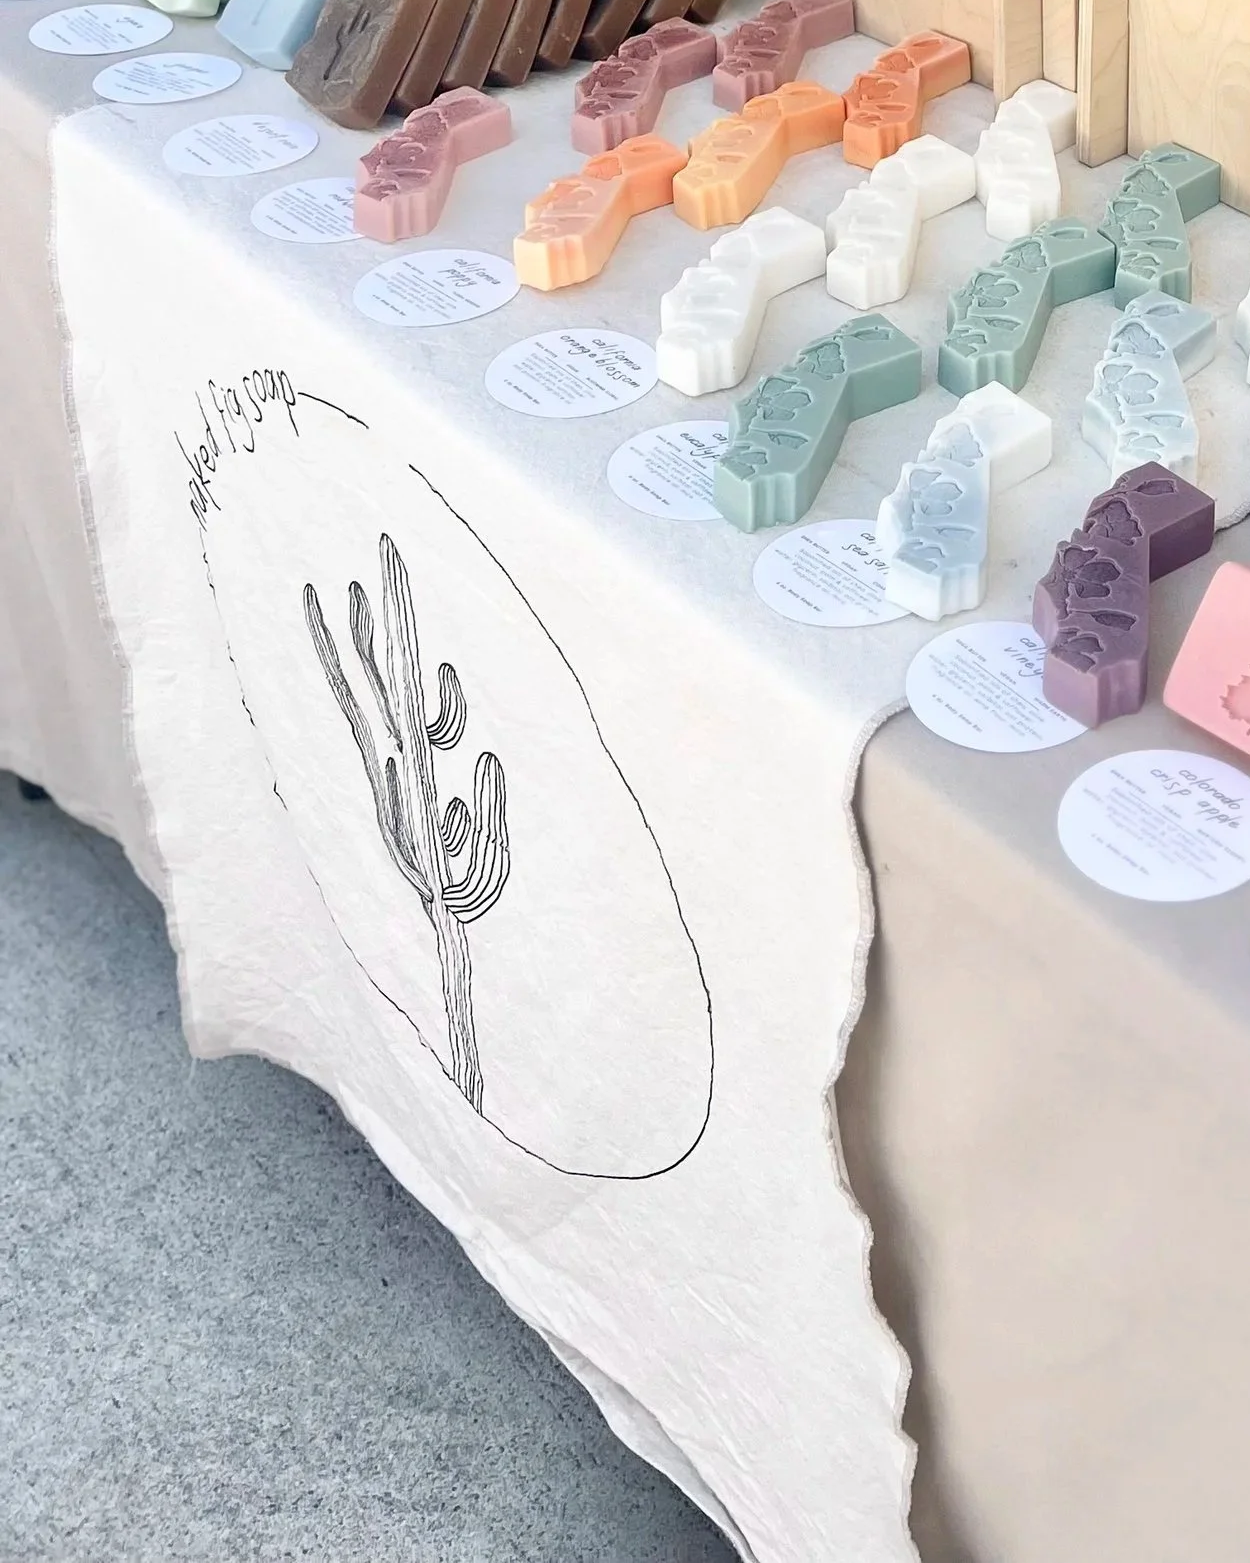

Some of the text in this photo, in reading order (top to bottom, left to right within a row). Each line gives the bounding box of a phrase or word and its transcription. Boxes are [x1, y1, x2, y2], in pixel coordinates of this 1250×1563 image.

[437, 268, 478, 288] poppy
[453, 257, 502, 286] california
[560, 334, 641, 388] orange blossom
[592, 338, 642, 371] california
[173, 368, 300, 533] naked fig soap
[841, 543, 869, 557] sea
[1003, 646, 1043, 678] viney
[1149, 768, 1242, 830] crisp apple
[1178, 769, 1244, 811] colorado
